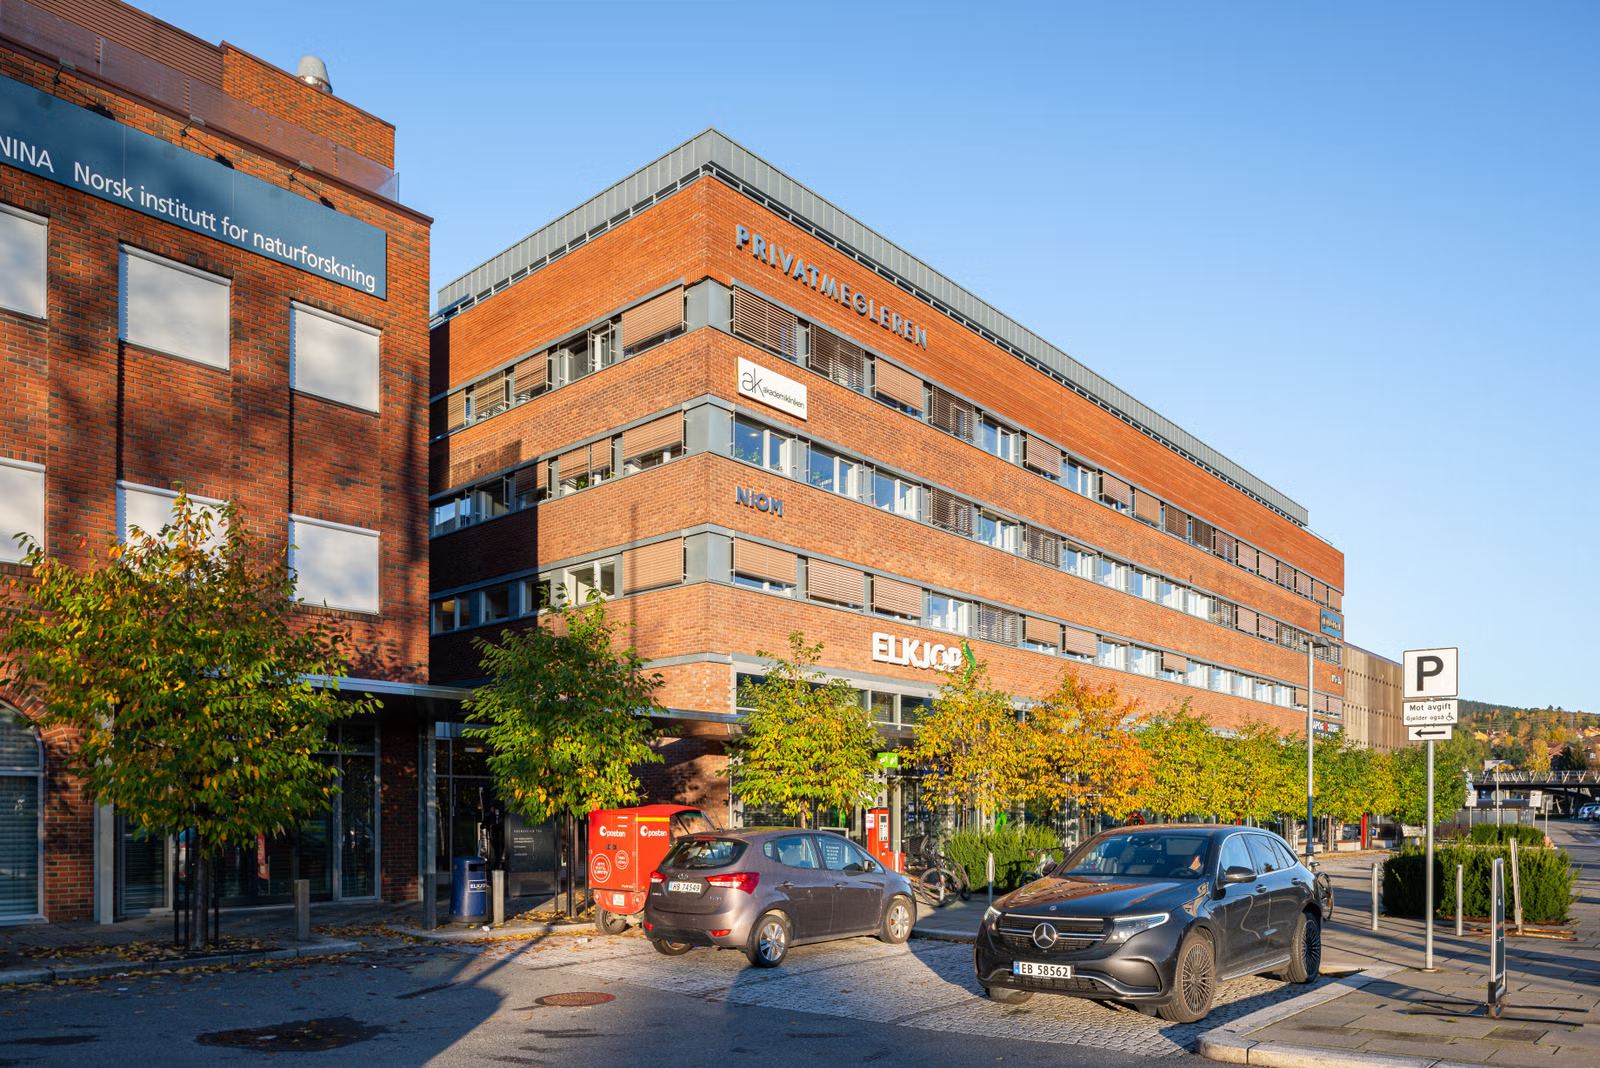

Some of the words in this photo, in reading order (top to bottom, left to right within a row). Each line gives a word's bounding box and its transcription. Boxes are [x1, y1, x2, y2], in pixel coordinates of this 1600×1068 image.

[0, 136, 54, 173] NINA
[74, 161, 134, 203] Norsk
[140, 185, 217, 232] institutt
[221, 216, 248, 241] for
[253, 232, 375, 293] naturforskning
[736, 223, 928, 350] PRIVATMEGLEREN
[741, 367, 765, 397] ak
[1416, 655, 1444, 691] P
[1409, 704, 1425, 712] Mot
[1427, 702, 1451, 712] avgift
[606, 829, 626, 838] posten
[647, 828, 668, 838] posten
[1021, 963, 1033, 974] EB
[1037, 964, 1068, 978] 58562
